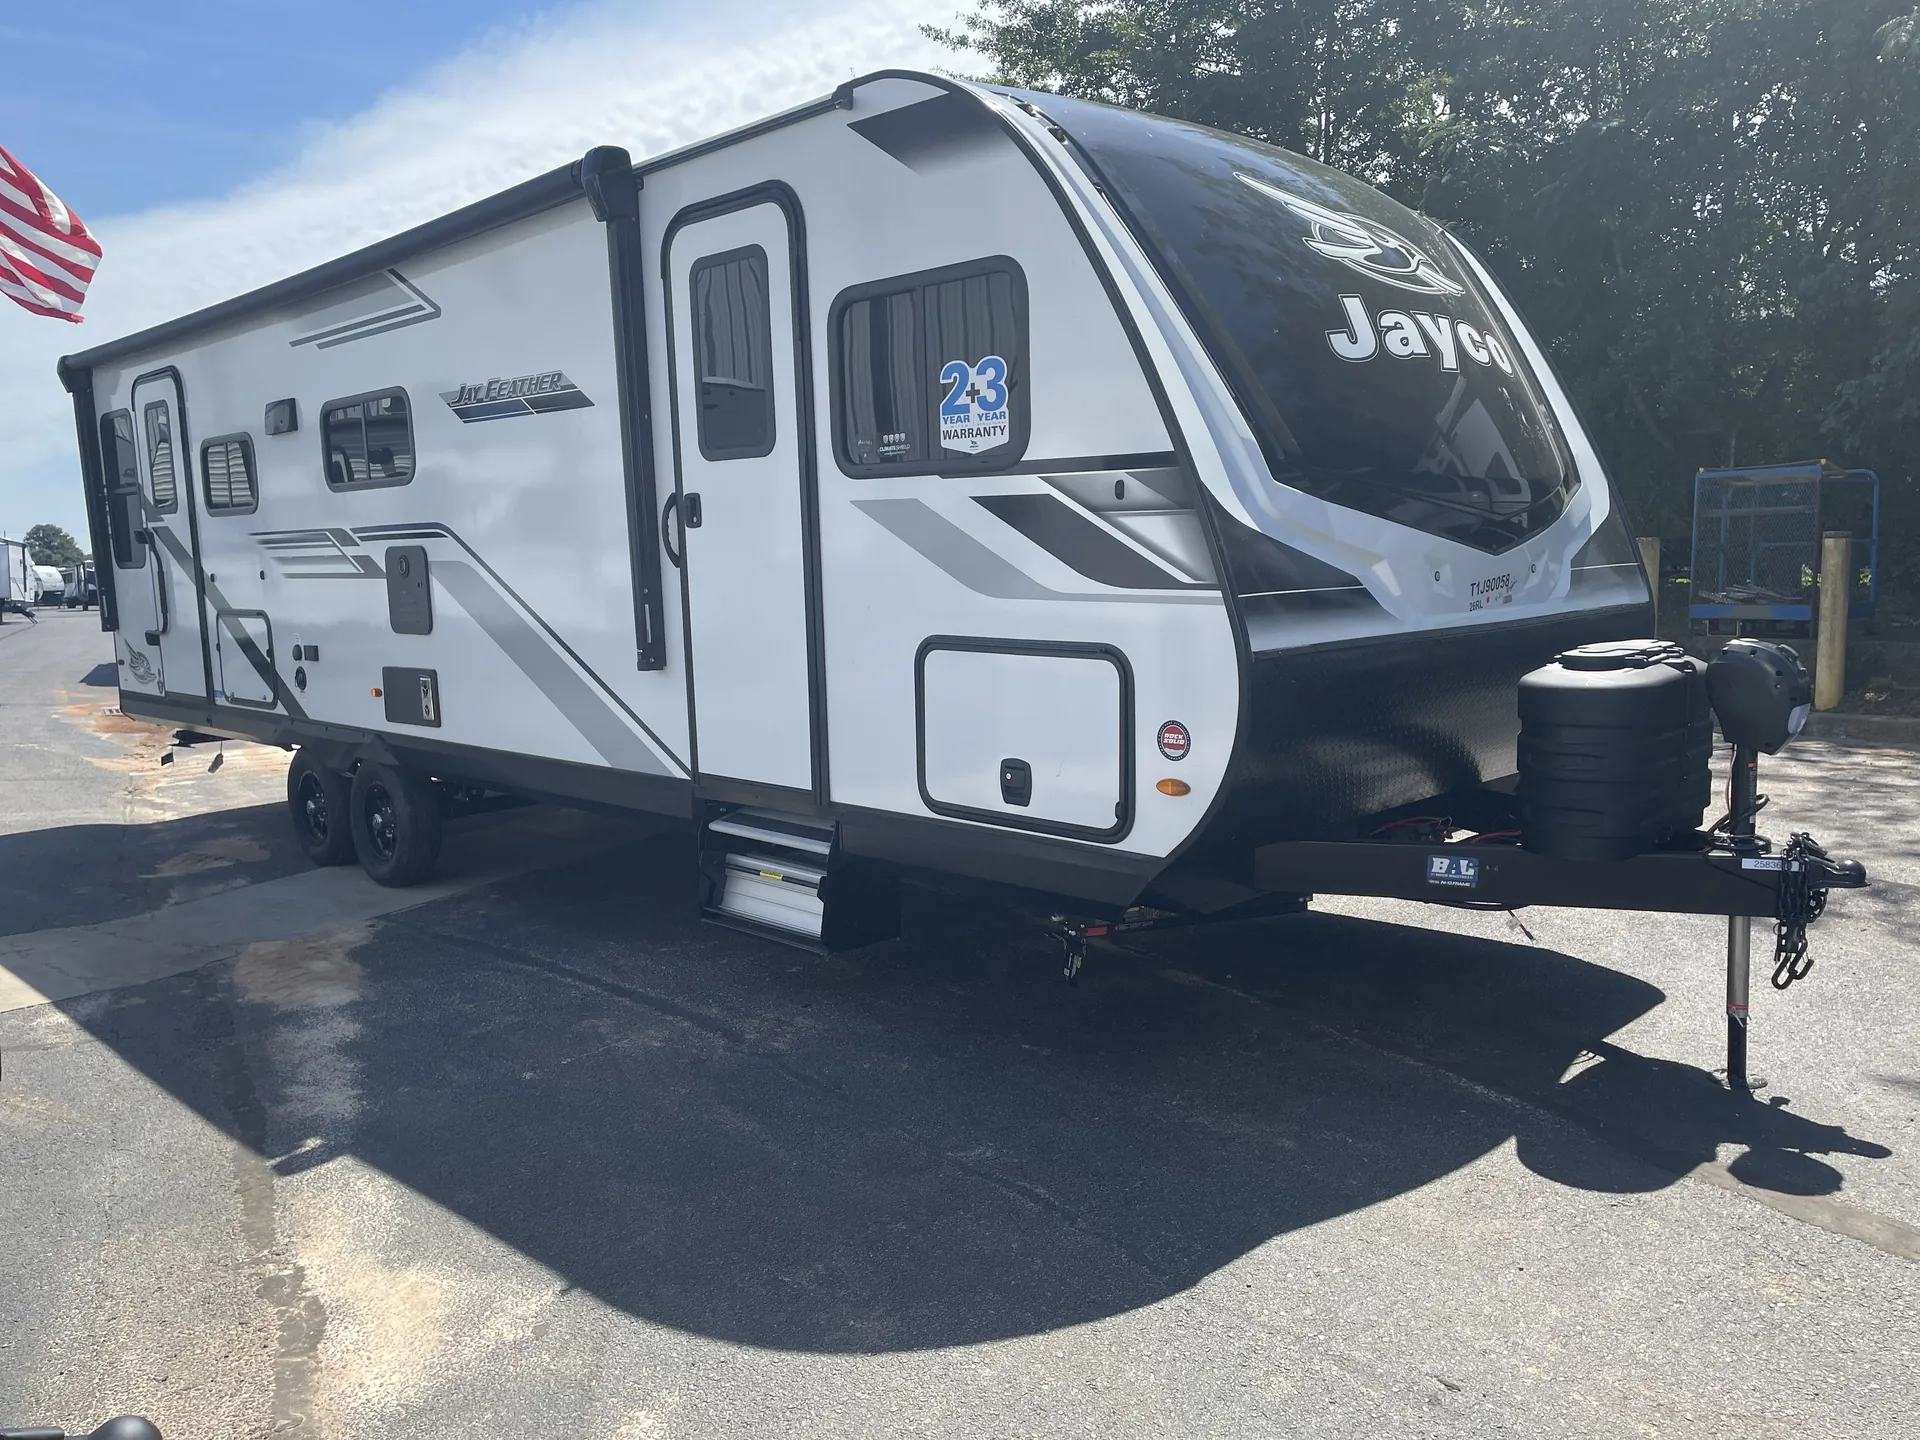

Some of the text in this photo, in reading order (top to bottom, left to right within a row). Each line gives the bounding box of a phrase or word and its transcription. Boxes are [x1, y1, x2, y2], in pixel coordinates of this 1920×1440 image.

[1325, 294, 1514, 377] Jayco
[451, 370, 563, 406] JAY FEATHER
[942, 411, 1006, 425] YEAR YEAR
[942, 425, 1006, 440] WARRANTY
[1470, 573, 1511, 597] T1J90058
[1469, 600, 1483, 612] 26RL
[1753, 860, 1782, 869] 25836
